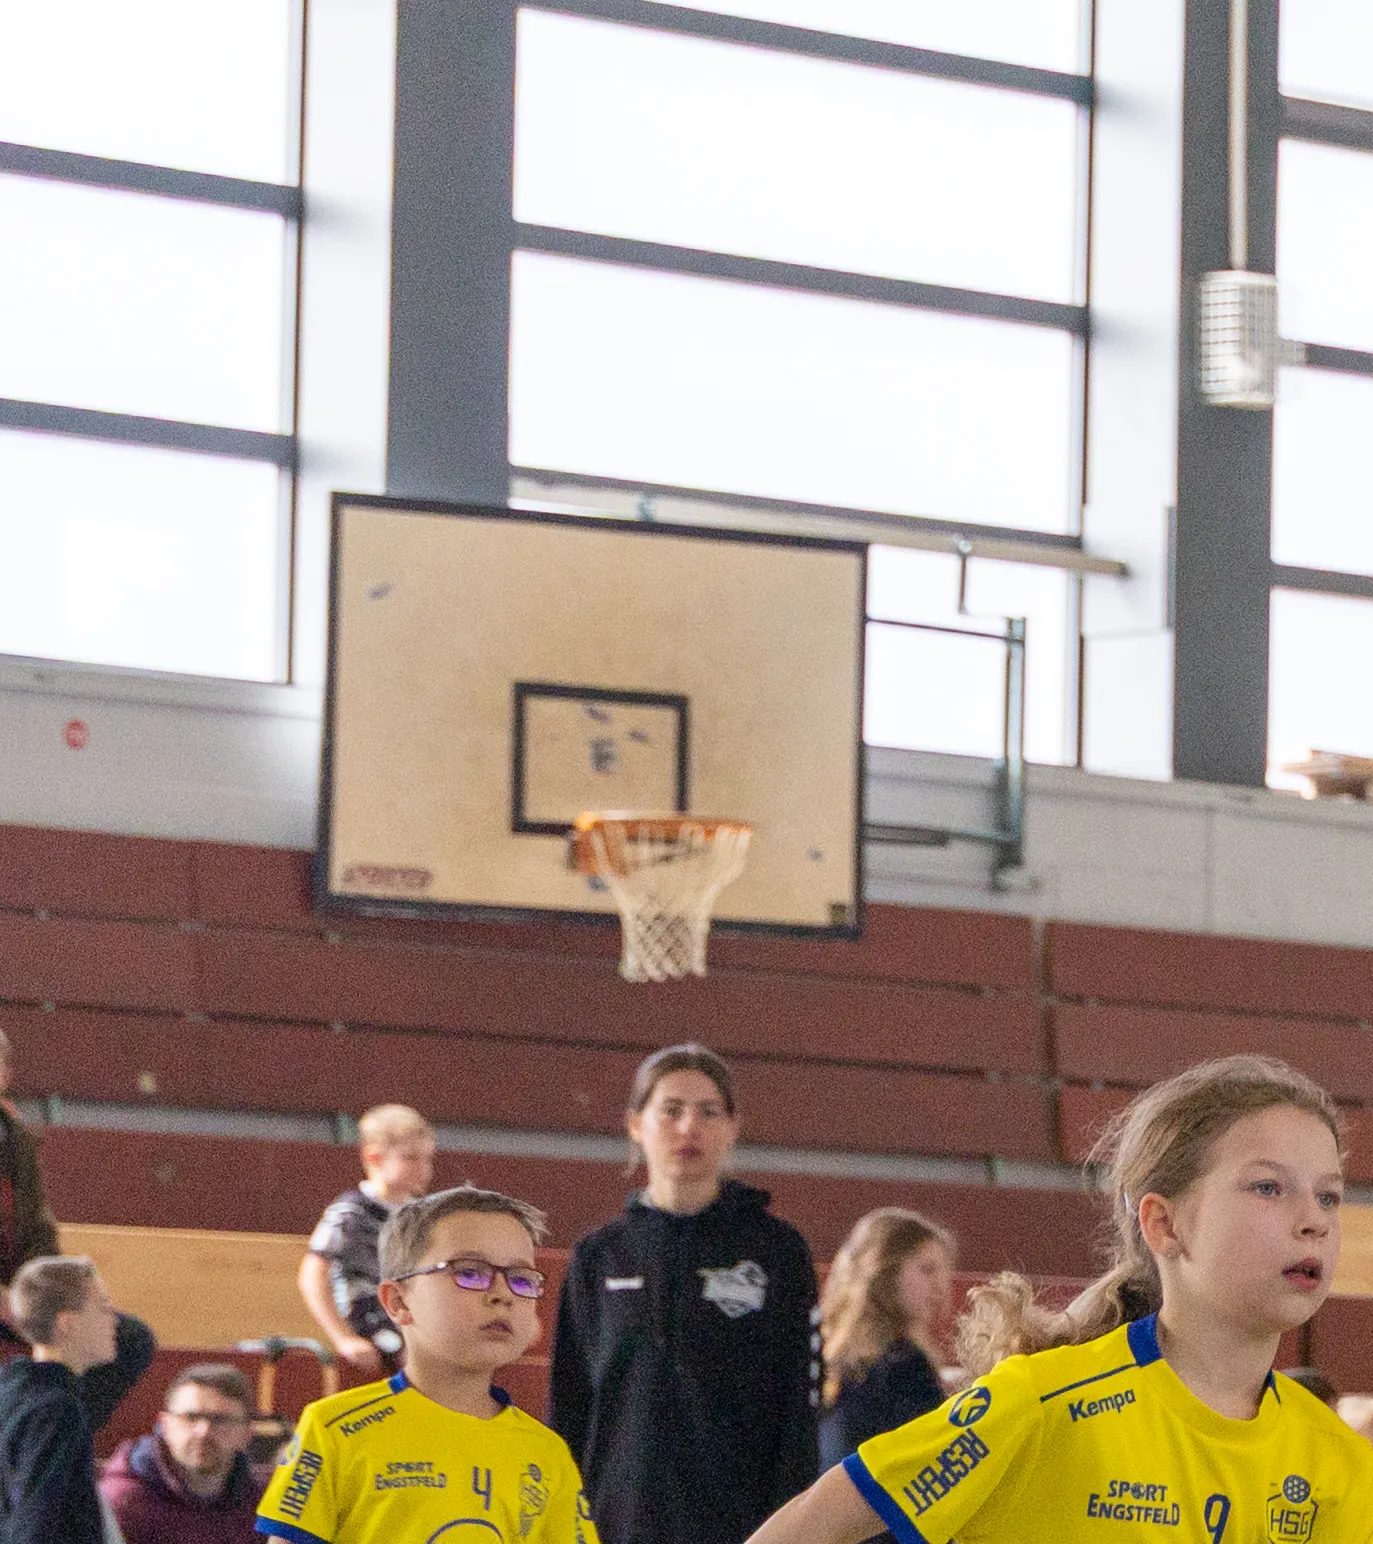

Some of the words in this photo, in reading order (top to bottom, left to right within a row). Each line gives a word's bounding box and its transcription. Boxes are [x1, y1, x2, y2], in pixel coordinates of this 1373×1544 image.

[1068, 1388, 1136, 1422] Kempa
[341, 1406, 397, 1437] Kempa
[471, 1465, 492, 1511] 4
[1106, 1479, 1168, 1500] SPORT
[1087, 1493, 1180, 1526] ENGSTFELD
[1268, 1507, 1313, 1537] HSG
